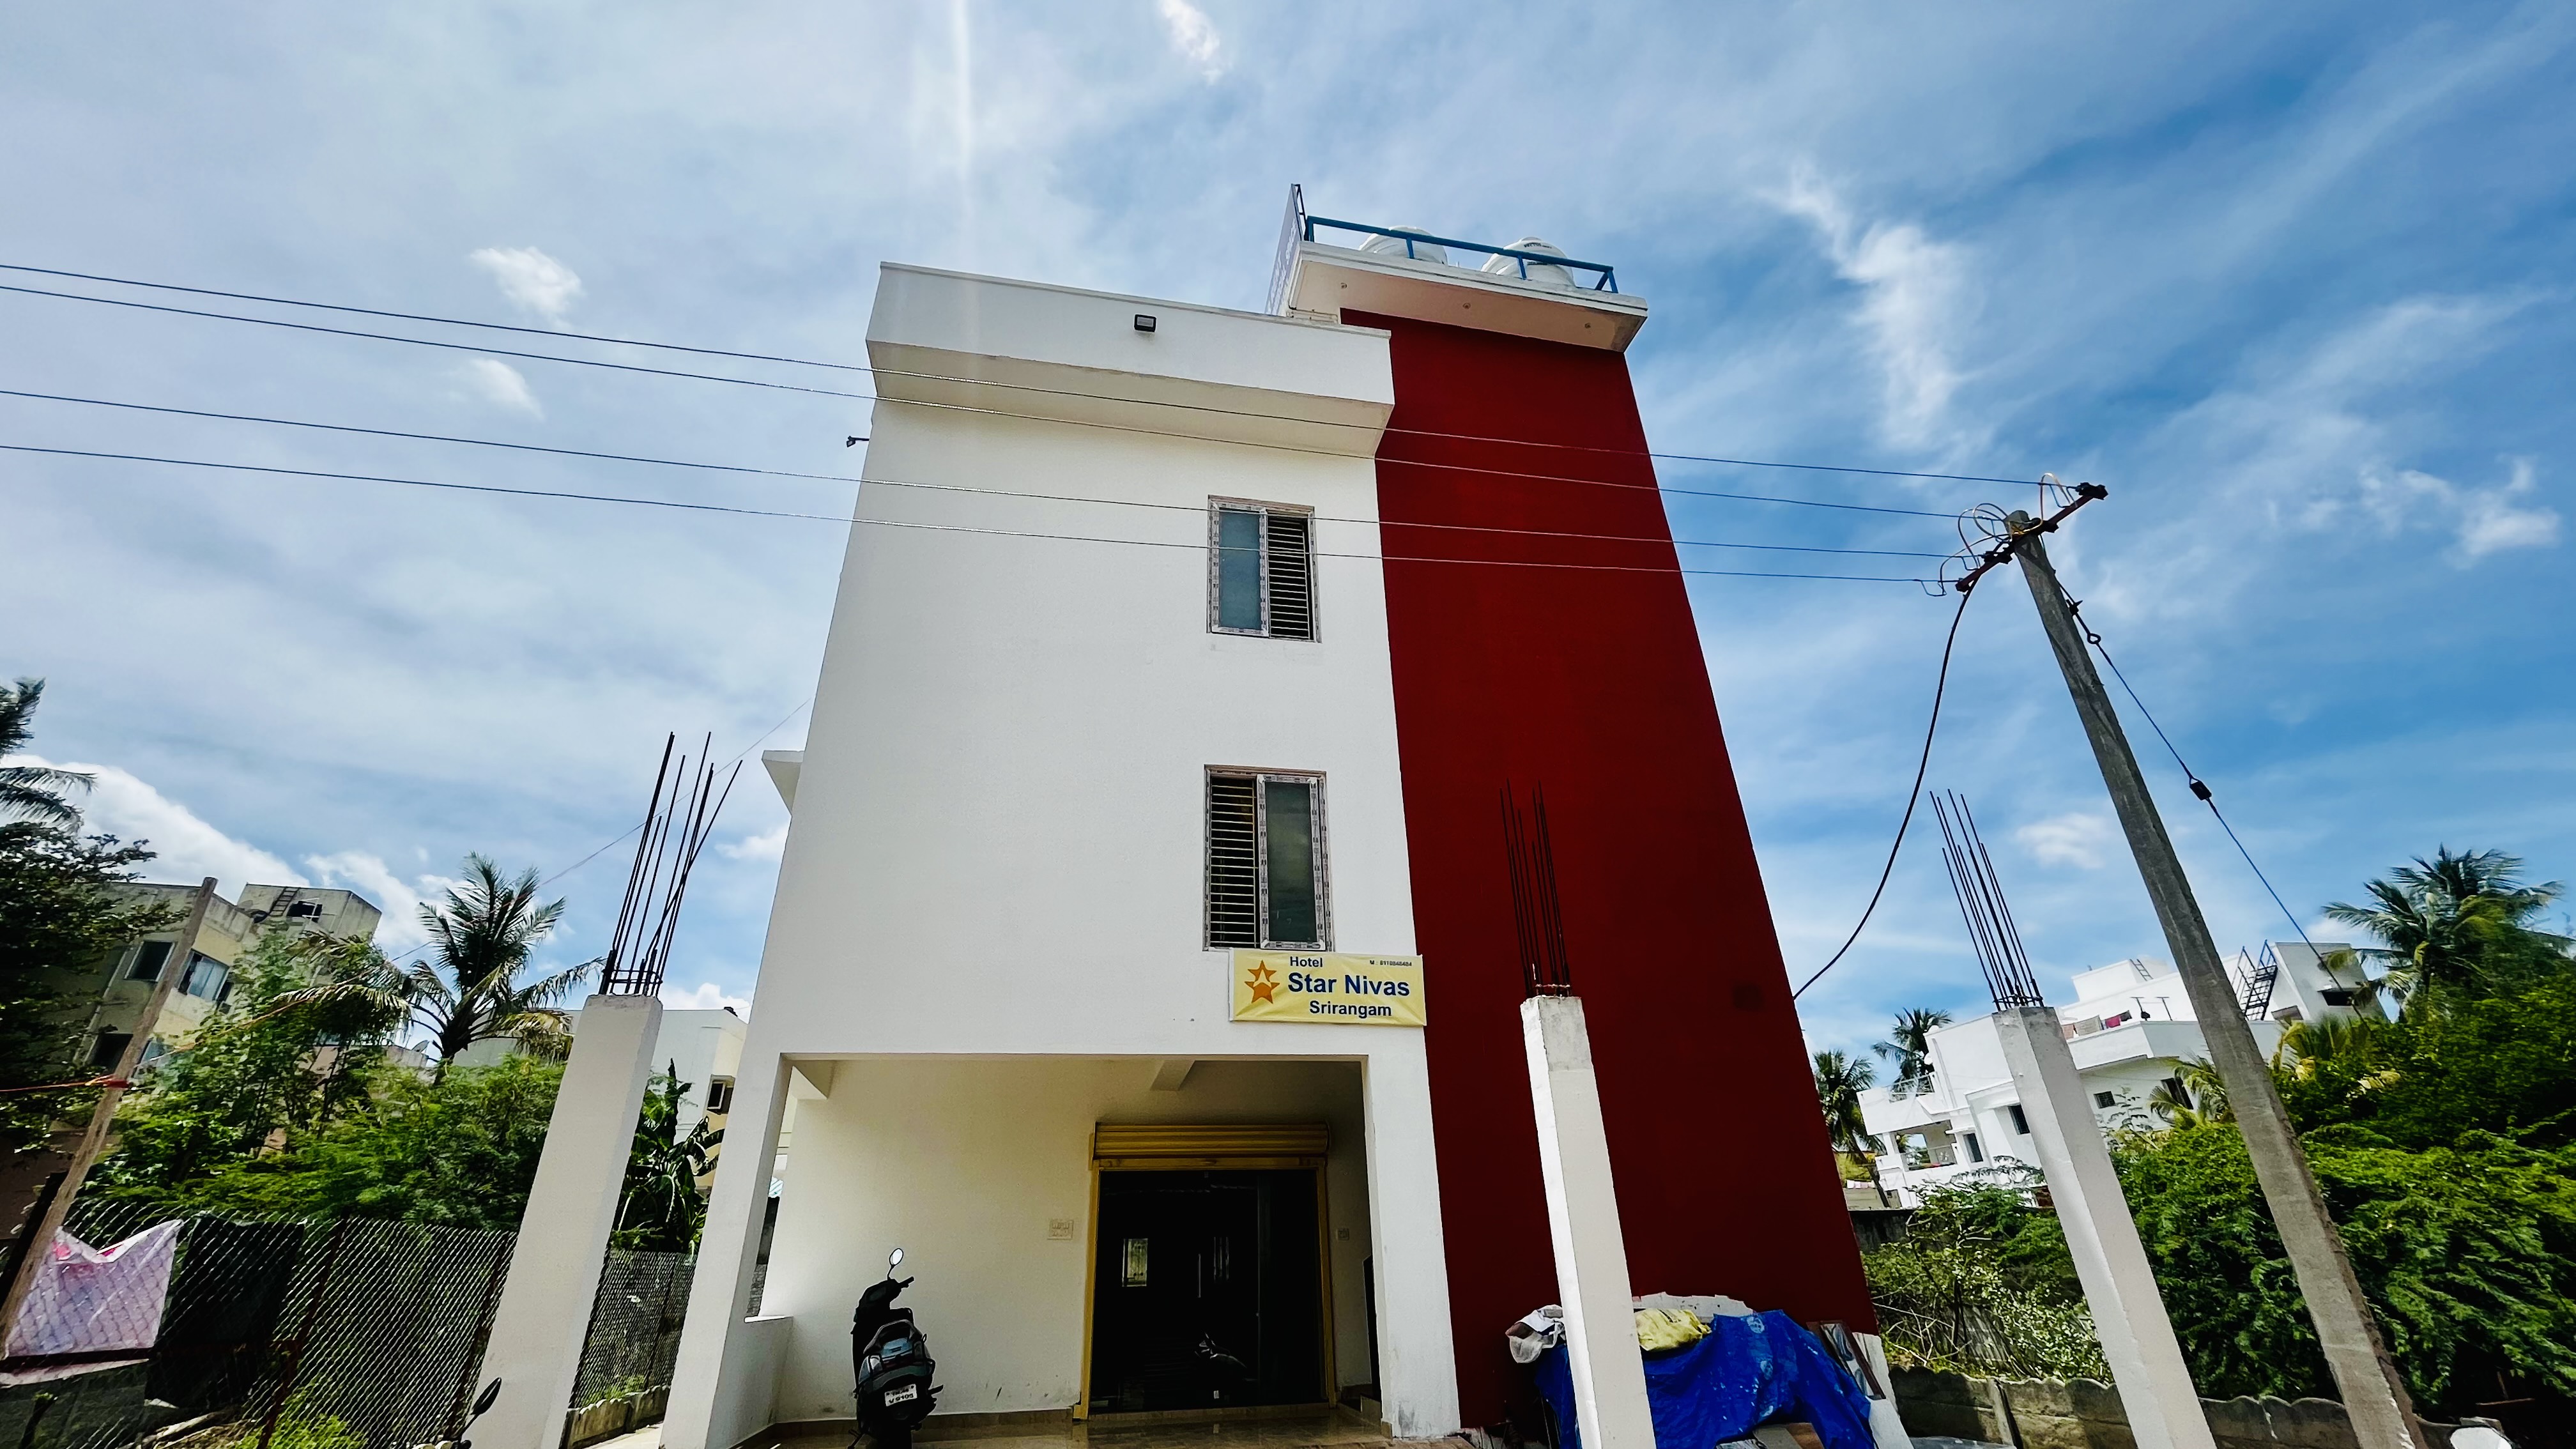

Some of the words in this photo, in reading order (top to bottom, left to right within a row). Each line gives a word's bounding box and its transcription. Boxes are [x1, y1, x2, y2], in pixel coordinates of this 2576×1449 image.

[1289, 956, 1323, 968] Hotel
[1288, 972, 1337, 993] Star
[1344, 974, 1410, 997] Nivas
[1309, 1000, 1392, 1019] Srirangam
